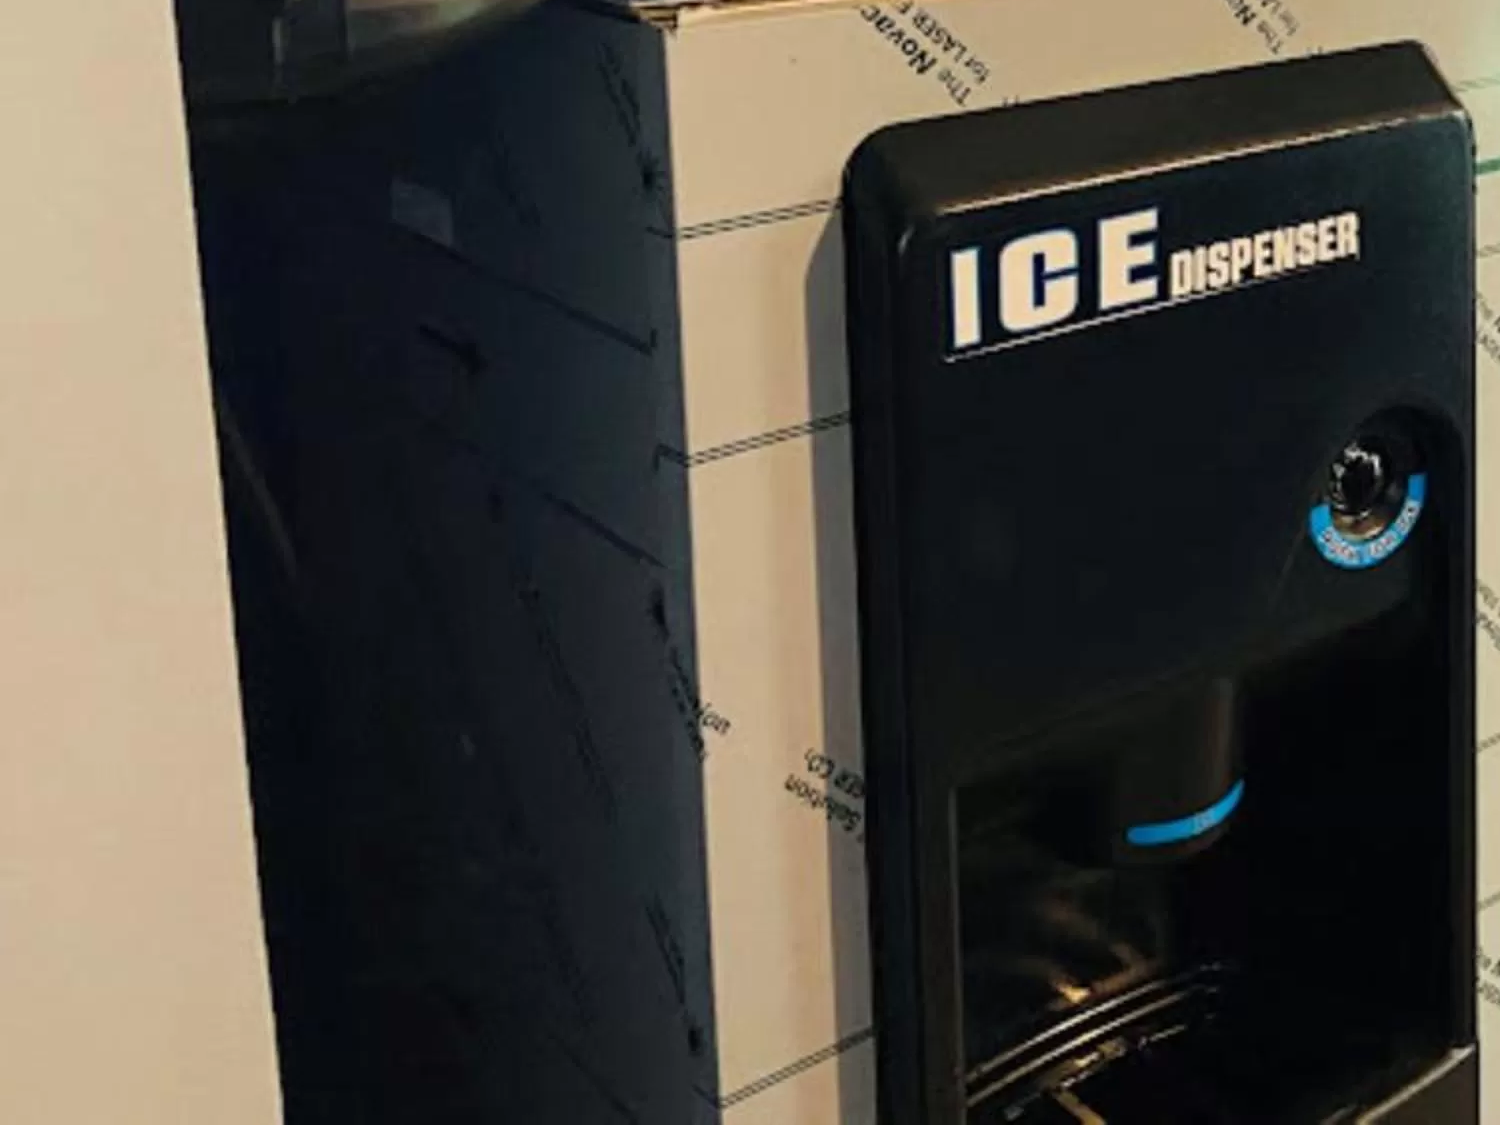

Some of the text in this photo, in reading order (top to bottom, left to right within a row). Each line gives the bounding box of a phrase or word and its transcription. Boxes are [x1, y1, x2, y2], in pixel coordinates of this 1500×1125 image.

[911, 7, 968, 63] LASER
[937, 68, 971, 107] The
[950, 207, 1361, 350] ICE DISPENSER
